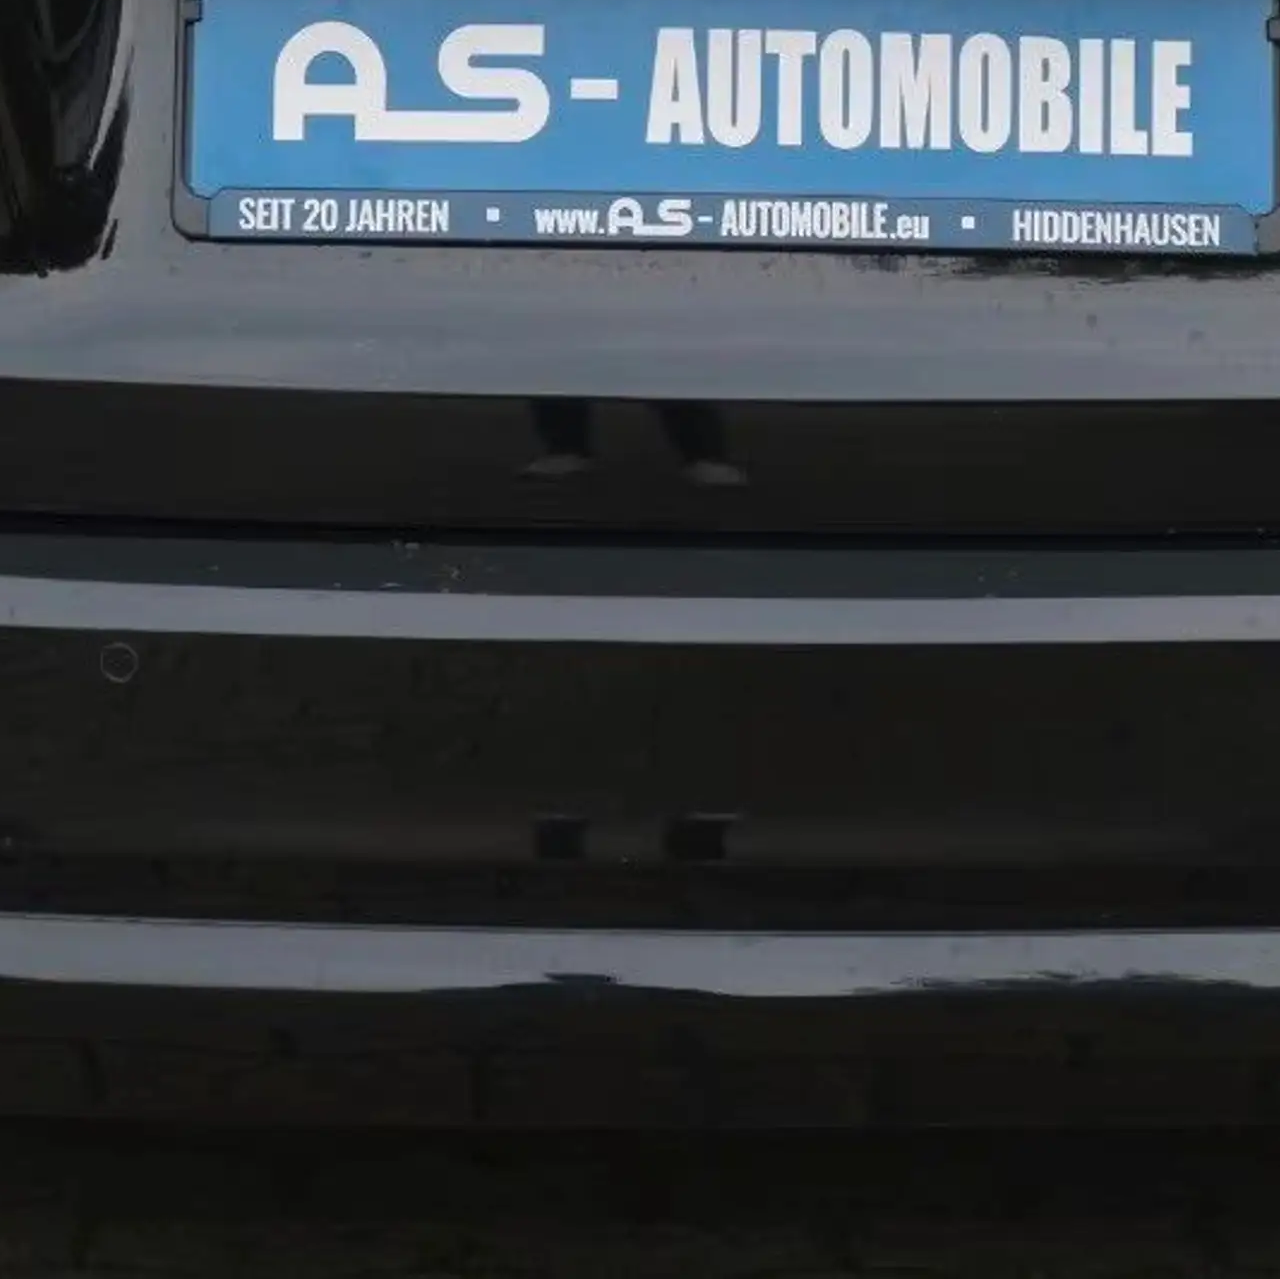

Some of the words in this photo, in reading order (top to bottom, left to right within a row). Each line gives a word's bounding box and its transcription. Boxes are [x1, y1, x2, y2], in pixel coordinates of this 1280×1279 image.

[239, 197, 295, 233] SEIT
[303, 198, 338, 233] 20
[345, 199, 449, 234] JAHREN
[1012, 208, 1221, 247] HIDDENHAUSEN
